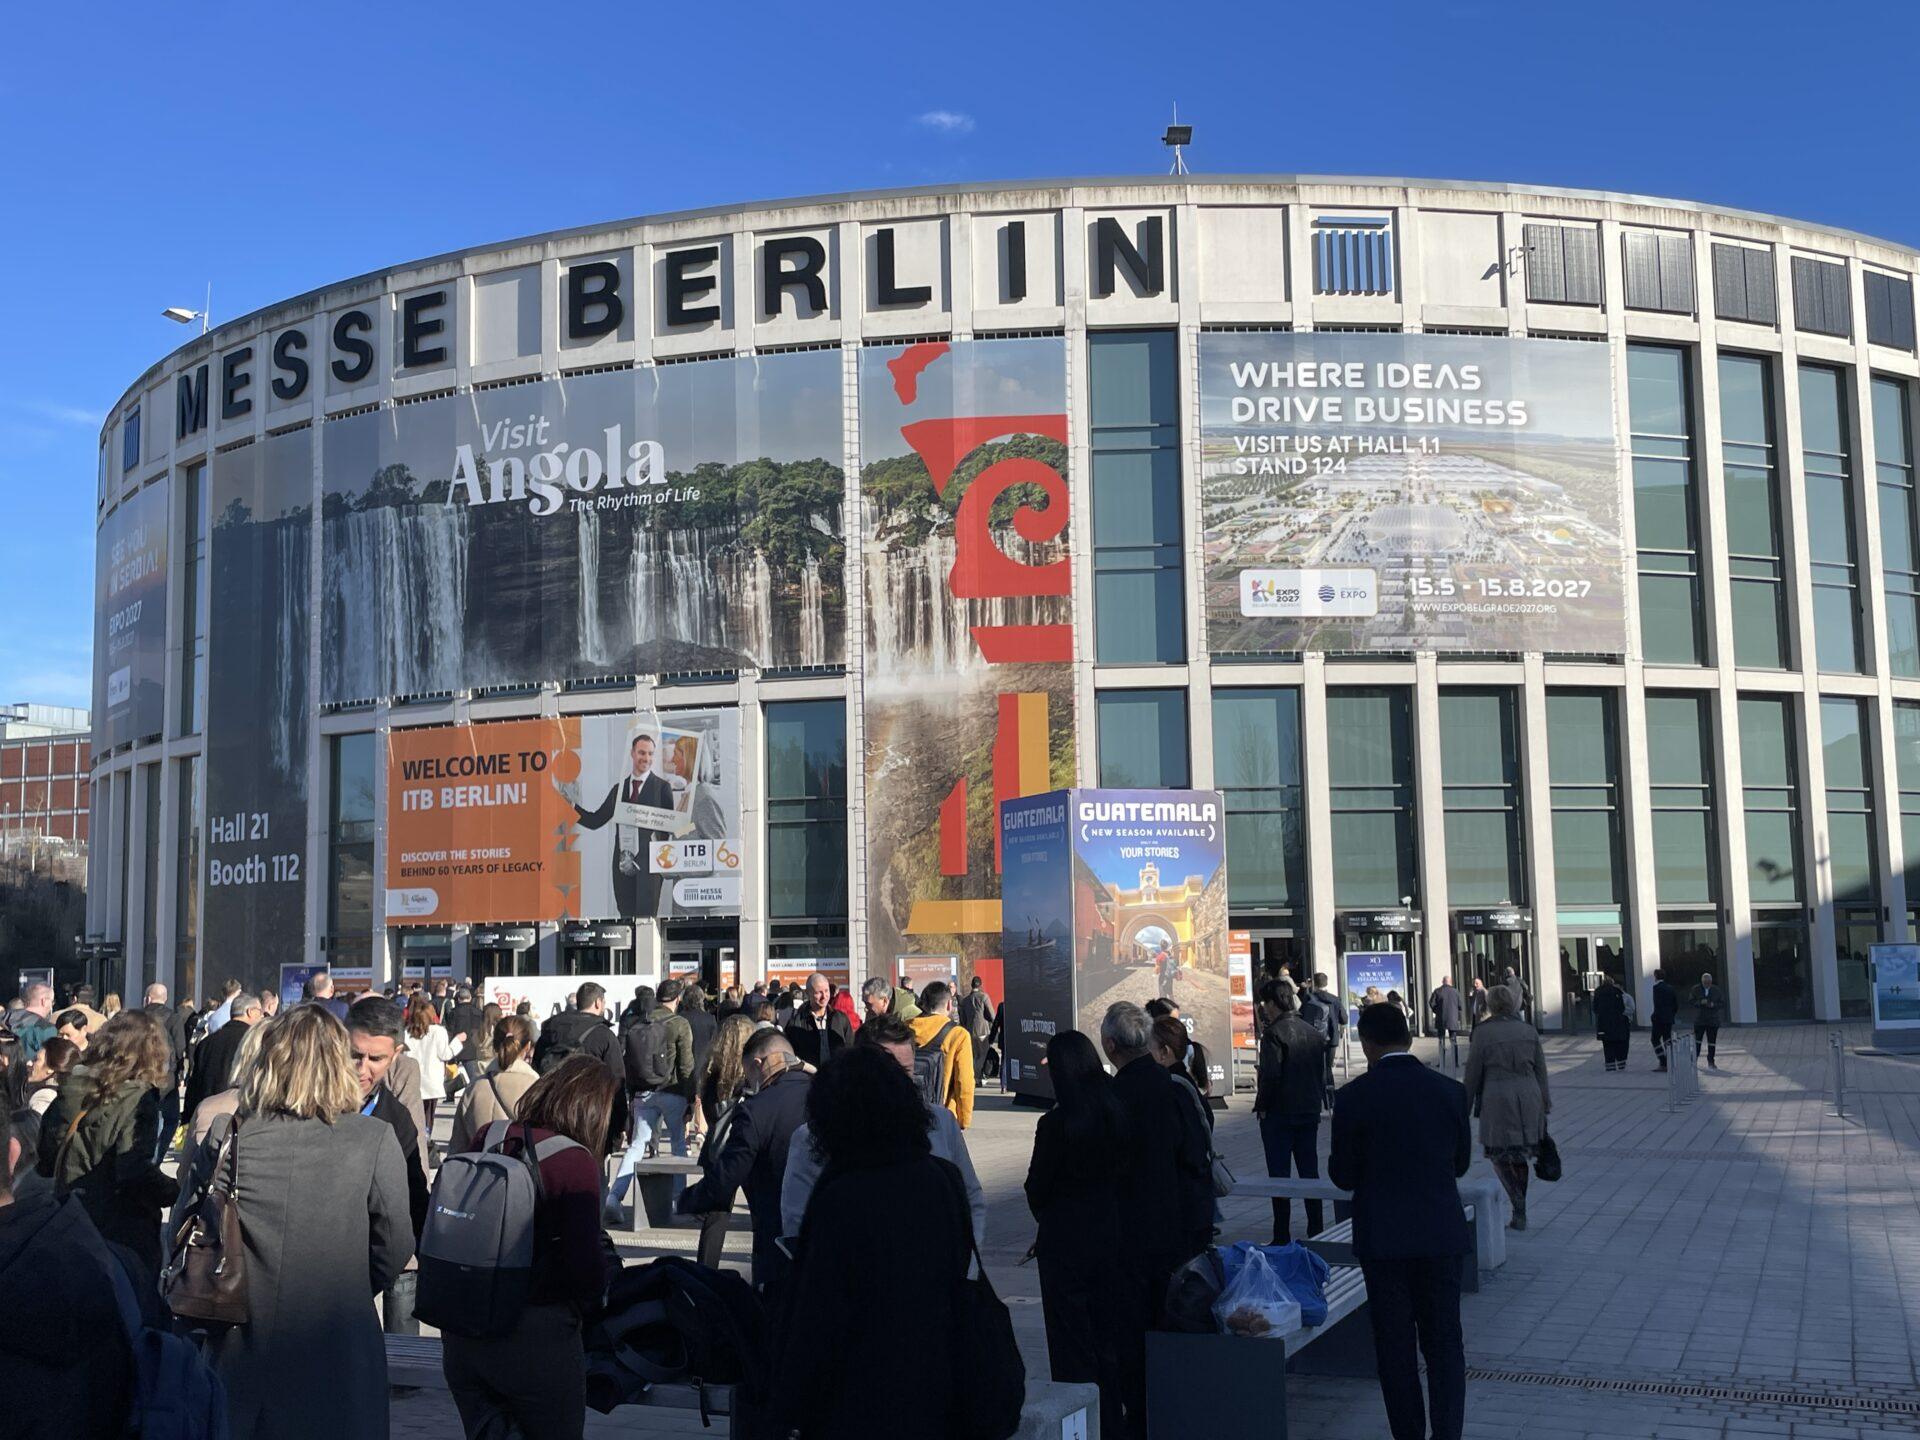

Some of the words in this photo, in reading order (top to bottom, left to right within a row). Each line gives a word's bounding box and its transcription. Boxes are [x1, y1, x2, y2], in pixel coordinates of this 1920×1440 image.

[176, 291, 447, 440] MESSE
[569, 216, 1164, 339] BERLIN
[1229, 361, 1365, 389] WHERE
[1377, 362, 1482, 391] IDEAS
[1231, 396, 1343, 423] DRIVE
[1354, 396, 1528, 426] BUSINESS
[481, 414, 550, 453] Visit
[1233, 435, 1289, 454] VISIT
[1294, 435, 1323, 454] US
[1327, 435, 1353, 454] AT
[1359, 436, 1415, 454] HALL
[444, 423, 668, 516] Angola
[1235, 456, 1308, 475] STAND
[1311, 456, 1347, 475] 124
[569, 498, 594, 512] The
[597, 492, 651, 513] Rhythm
[655, 488, 673, 504] of
[674, 486, 700, 501] Life
[1340, 591, 1367, 599] EXPO
[1409, 577, 1455, 596] 15.5
[1478, 578, 1592, 598] 15.8.2027
[402, 753, 511, 781] WELCOME
[518, 751, 548, 773] TO
[402, 789, 434, 812] ITB
[441, 782, 527, 809] BERLIN!
[1004, 805, 1065, 831] GUATEMALA
[1080, 802, 1217, 822] GUATEMALA
[211, 812, 246, 844] Hall
[250, 812, 269, 840] 21
[1091, 828, 1113, 837] NEW
[1116, 828, 1153, 837] SEASON
[1156, 828, 1206, 837] AVAILABLE
[401, 851, 447, 863] DISCOVER
[450, 849, 467, 861] THE
[470, 847, 511, 859] STORIES
[684, 844, 706, 857] ITB
[1120, 847, 1143, 859] YOUR
[1144, 846, 1180, 859] STORIES
[210, 853, 267, 886] Booth
[272, 853, 300, 882] 112
[400, 866, 436, 877] BEHIND
[438, 866, 450, 876] 60
[452, 864, 484, 875] YEARS
[486, 863, 500, 873] OF
[502, 862, 545, 873] LEGACY.
[683, 860, 707, 868] BERLIN
